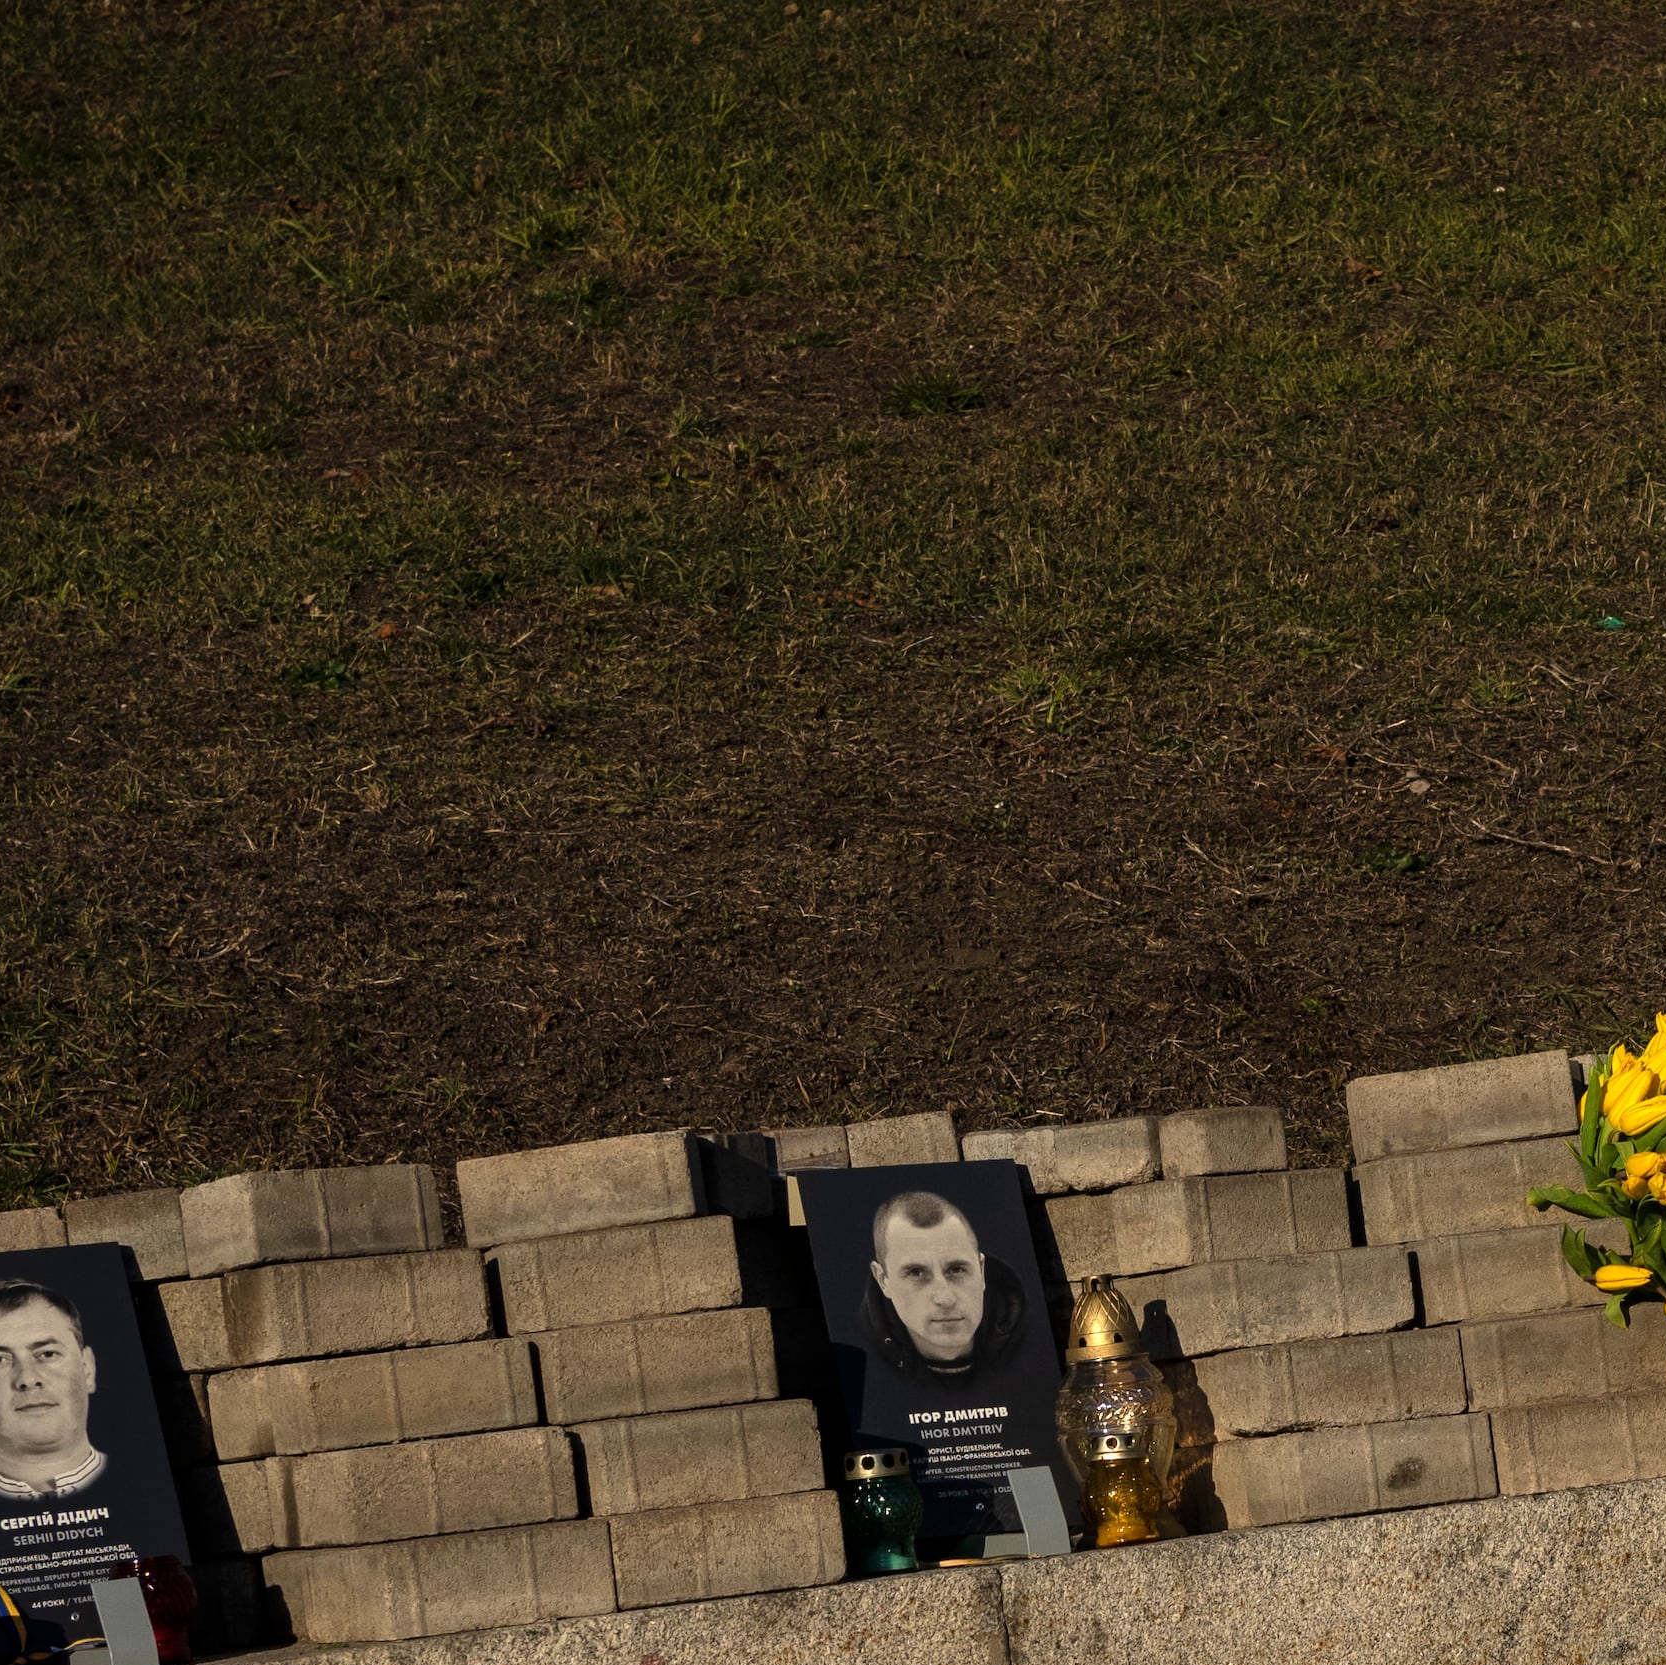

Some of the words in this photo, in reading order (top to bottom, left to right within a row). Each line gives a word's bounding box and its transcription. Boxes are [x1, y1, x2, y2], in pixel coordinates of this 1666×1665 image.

[908, 1411, 942, 1425] ІГОР
[944, 1406, 1009, 1423] ДМИТРІВ
[920, 1426, 951, 1440] IHOR
[953, 1423, 1004, 1437] DMYTRIV
[945, 1463, 993, 1474] CONSTRUCTION
[0, 1511, 54, 1530] СЕРГІЙ
[57, 1507, 110, 1525] ДІДИЧ
[13, 1533, 54, 1547] SERHII
[56, 1526, 104, 1542] DIDYCH
[51, 1549, 84, 1560] ДЕПУТАТ
[44, 1572, 71, 1583] DEPUTY
[71, 1571, 81, 1579] OF
[82, 1569, 96, 1577] THE
[31, 1601, 42, 1609] 44
[43, 1598, 66, 1608] РОКИ
